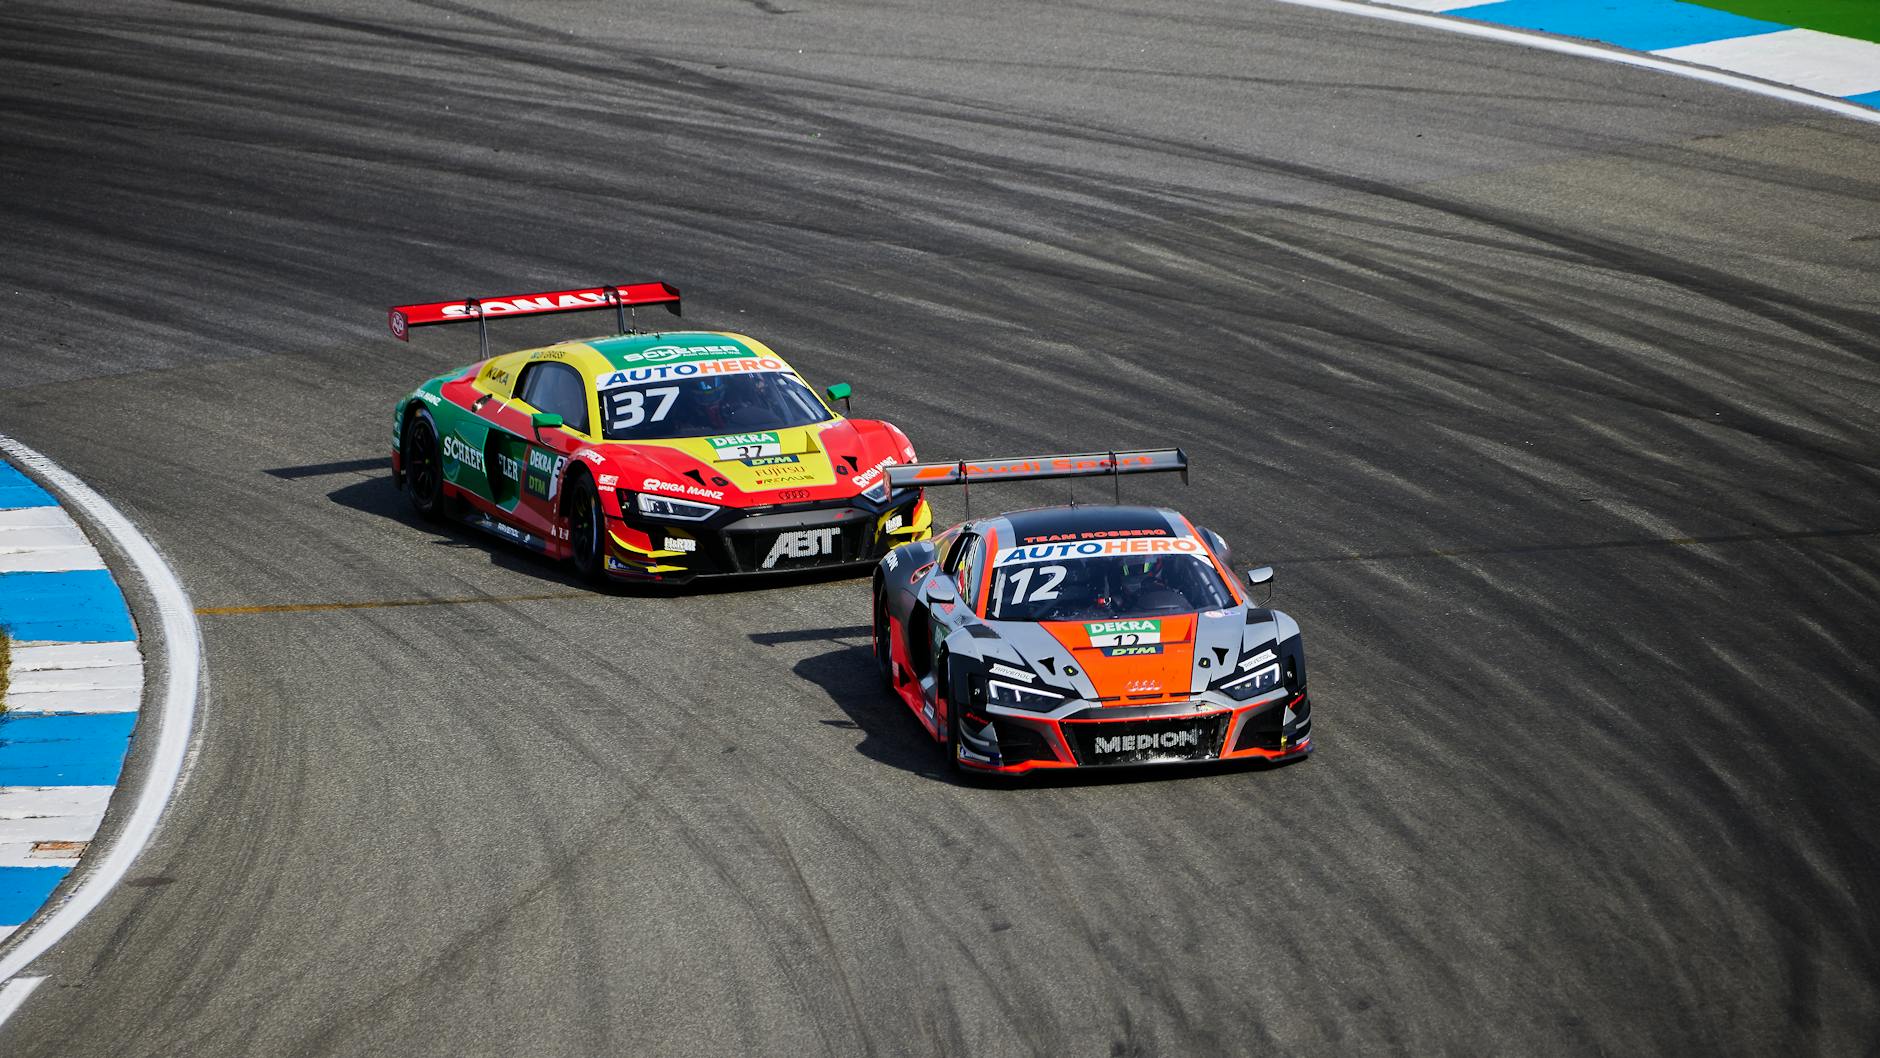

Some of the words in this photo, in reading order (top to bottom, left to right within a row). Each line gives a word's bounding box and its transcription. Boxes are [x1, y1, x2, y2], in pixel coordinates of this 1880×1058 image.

[604, 357, 782, 387] AUTOHERO
[612, 386, 680, 430] 37
[712, 433, 775, 447] DEKRA
[737, 445, 762, 459] 37
[530, 448, 551, 474] DEKRA
[751, 456, 792, 466] DTM
[964, 460, 1041, 475] Audi
[755, 465, 807, 476] FUJITSU
[529, 475, 546, 495] DTM
[659, 480, 685, 494] RIGA
[687, 486, 724, 500] MAINZ
[1024, 533, 1076, 543] TEAM
[1081, 529, 1167, 539] ROSBERG
[762, 527, 840, 568] ABT
[1003, 539, 1197, 562] AUTOHERO
[1009, 565, 1067, 606] 12
[1091, 620, 1156, 634] DEKRA
[1113, 633, 1140, 647] 12
[1112, 646, 1156, 656] DTM
[994, 666, 1031, 680] RAVENOL
[1095, 728, 1198, 754] MEDION
